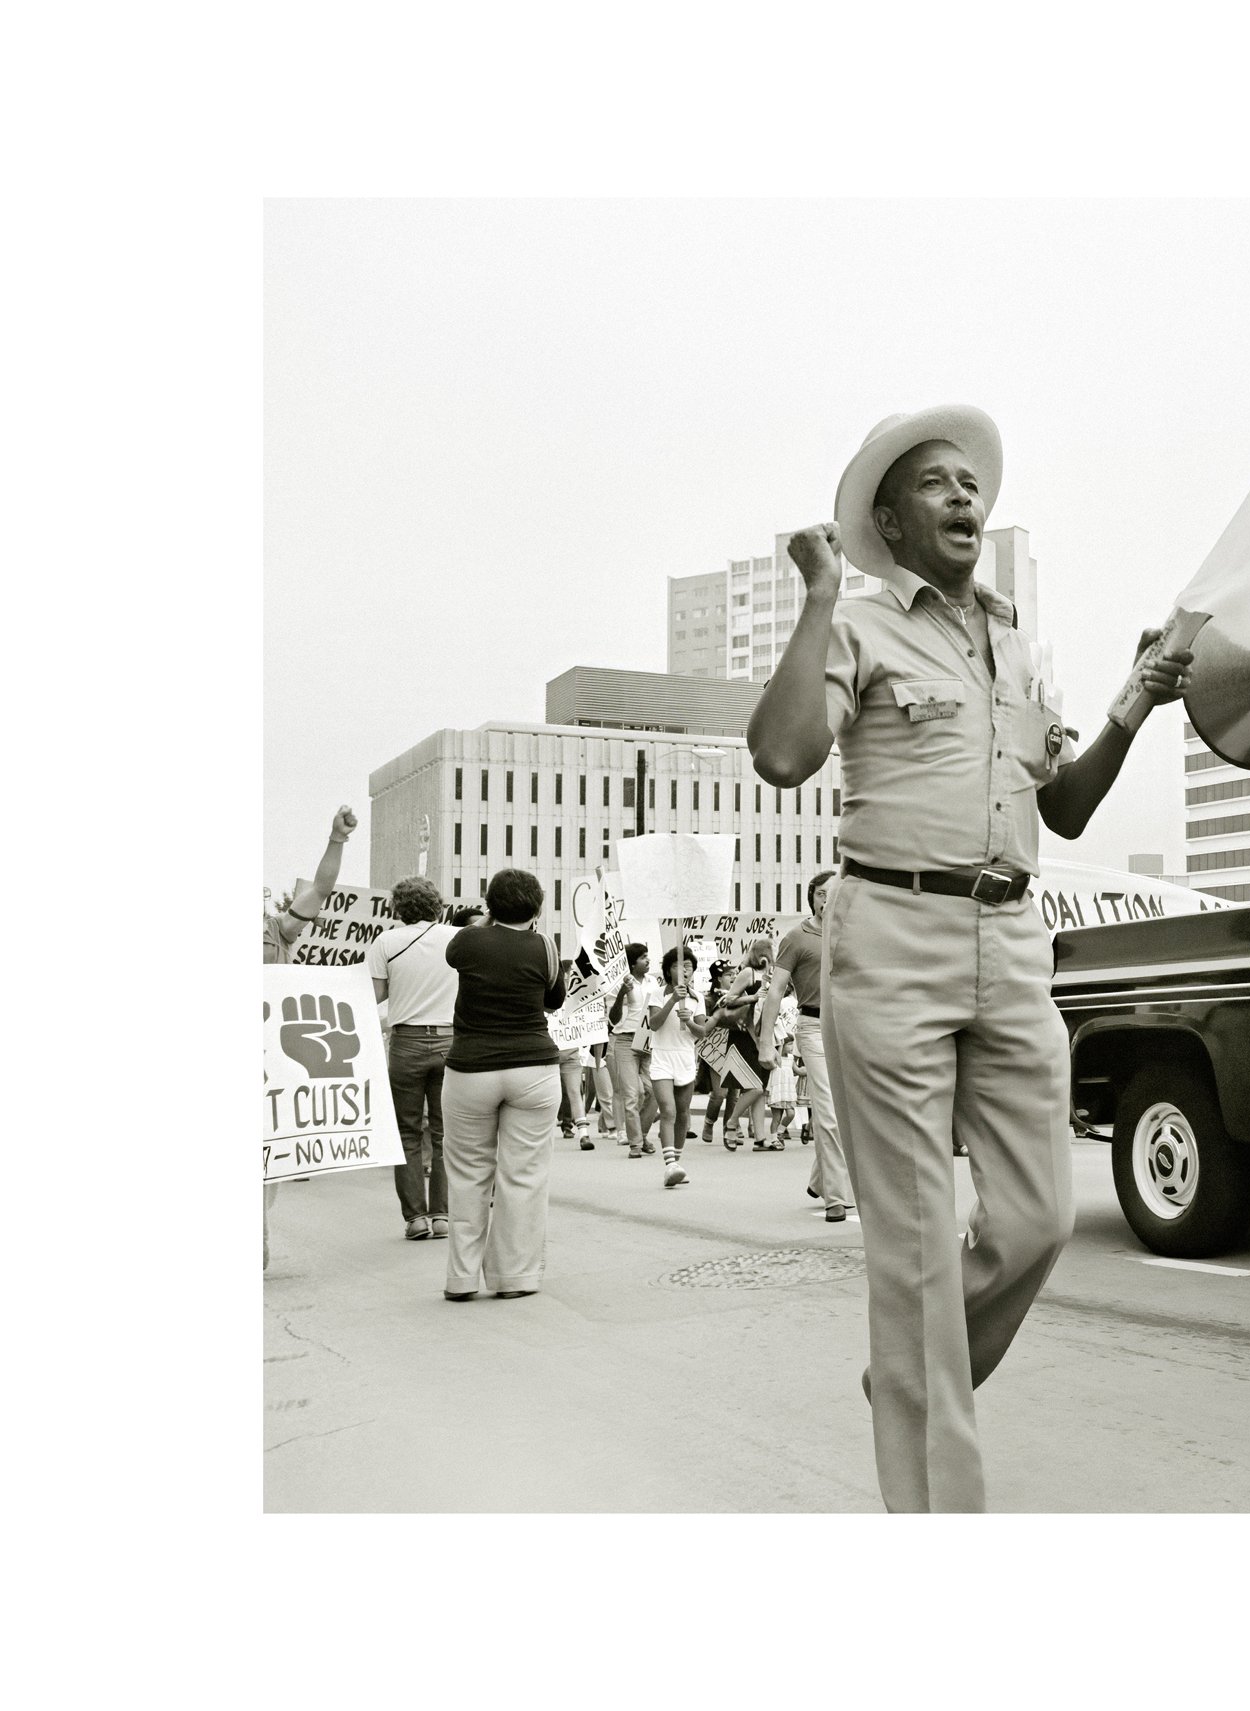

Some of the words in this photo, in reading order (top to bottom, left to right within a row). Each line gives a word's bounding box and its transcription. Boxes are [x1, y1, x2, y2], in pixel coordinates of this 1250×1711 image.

[319, 891, 358, 913] TOP
[1027, 889, 1165, 931] OALITION
[715, 916, 739, 932] FOR
[293, 1078, 372, 1129] CUTS!
[295, 1138, 324, 1166] NO
[329, 1135, 370, 1161] WAR
